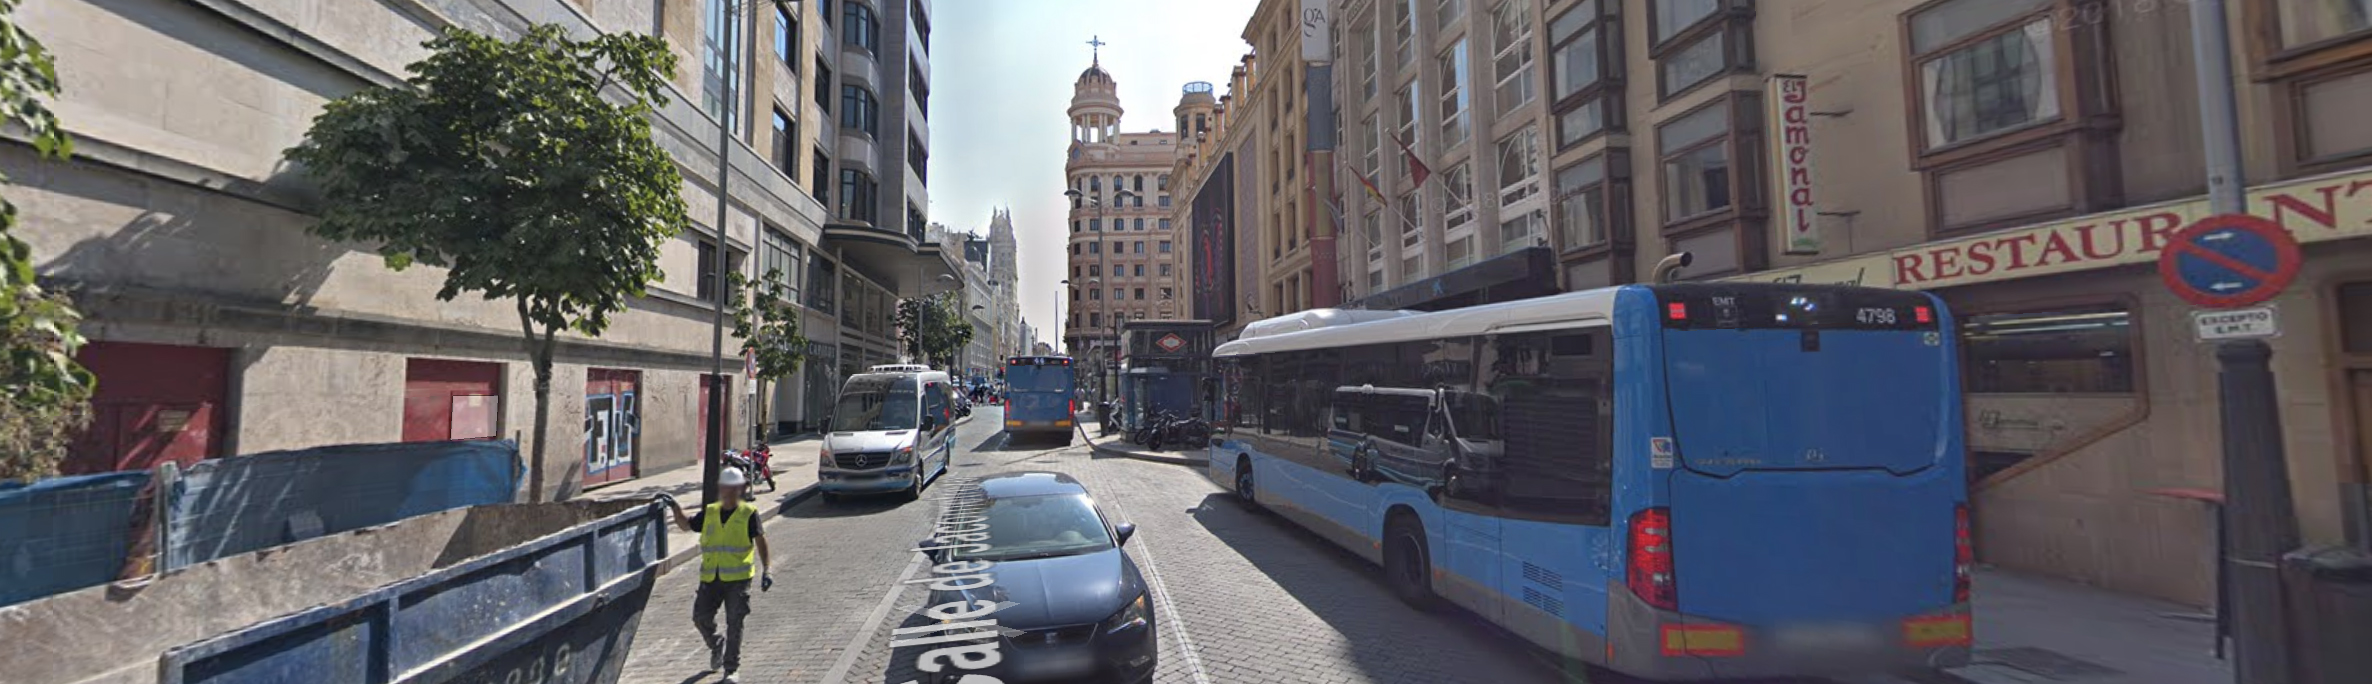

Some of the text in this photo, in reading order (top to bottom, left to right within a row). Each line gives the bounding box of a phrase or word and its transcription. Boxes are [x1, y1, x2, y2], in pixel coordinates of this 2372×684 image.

[1784, 80, 1814, 232] Jamonal
[1893, 180, 2372, 286] RESTAURN
[1856, 307, 1896, 325] 4798
